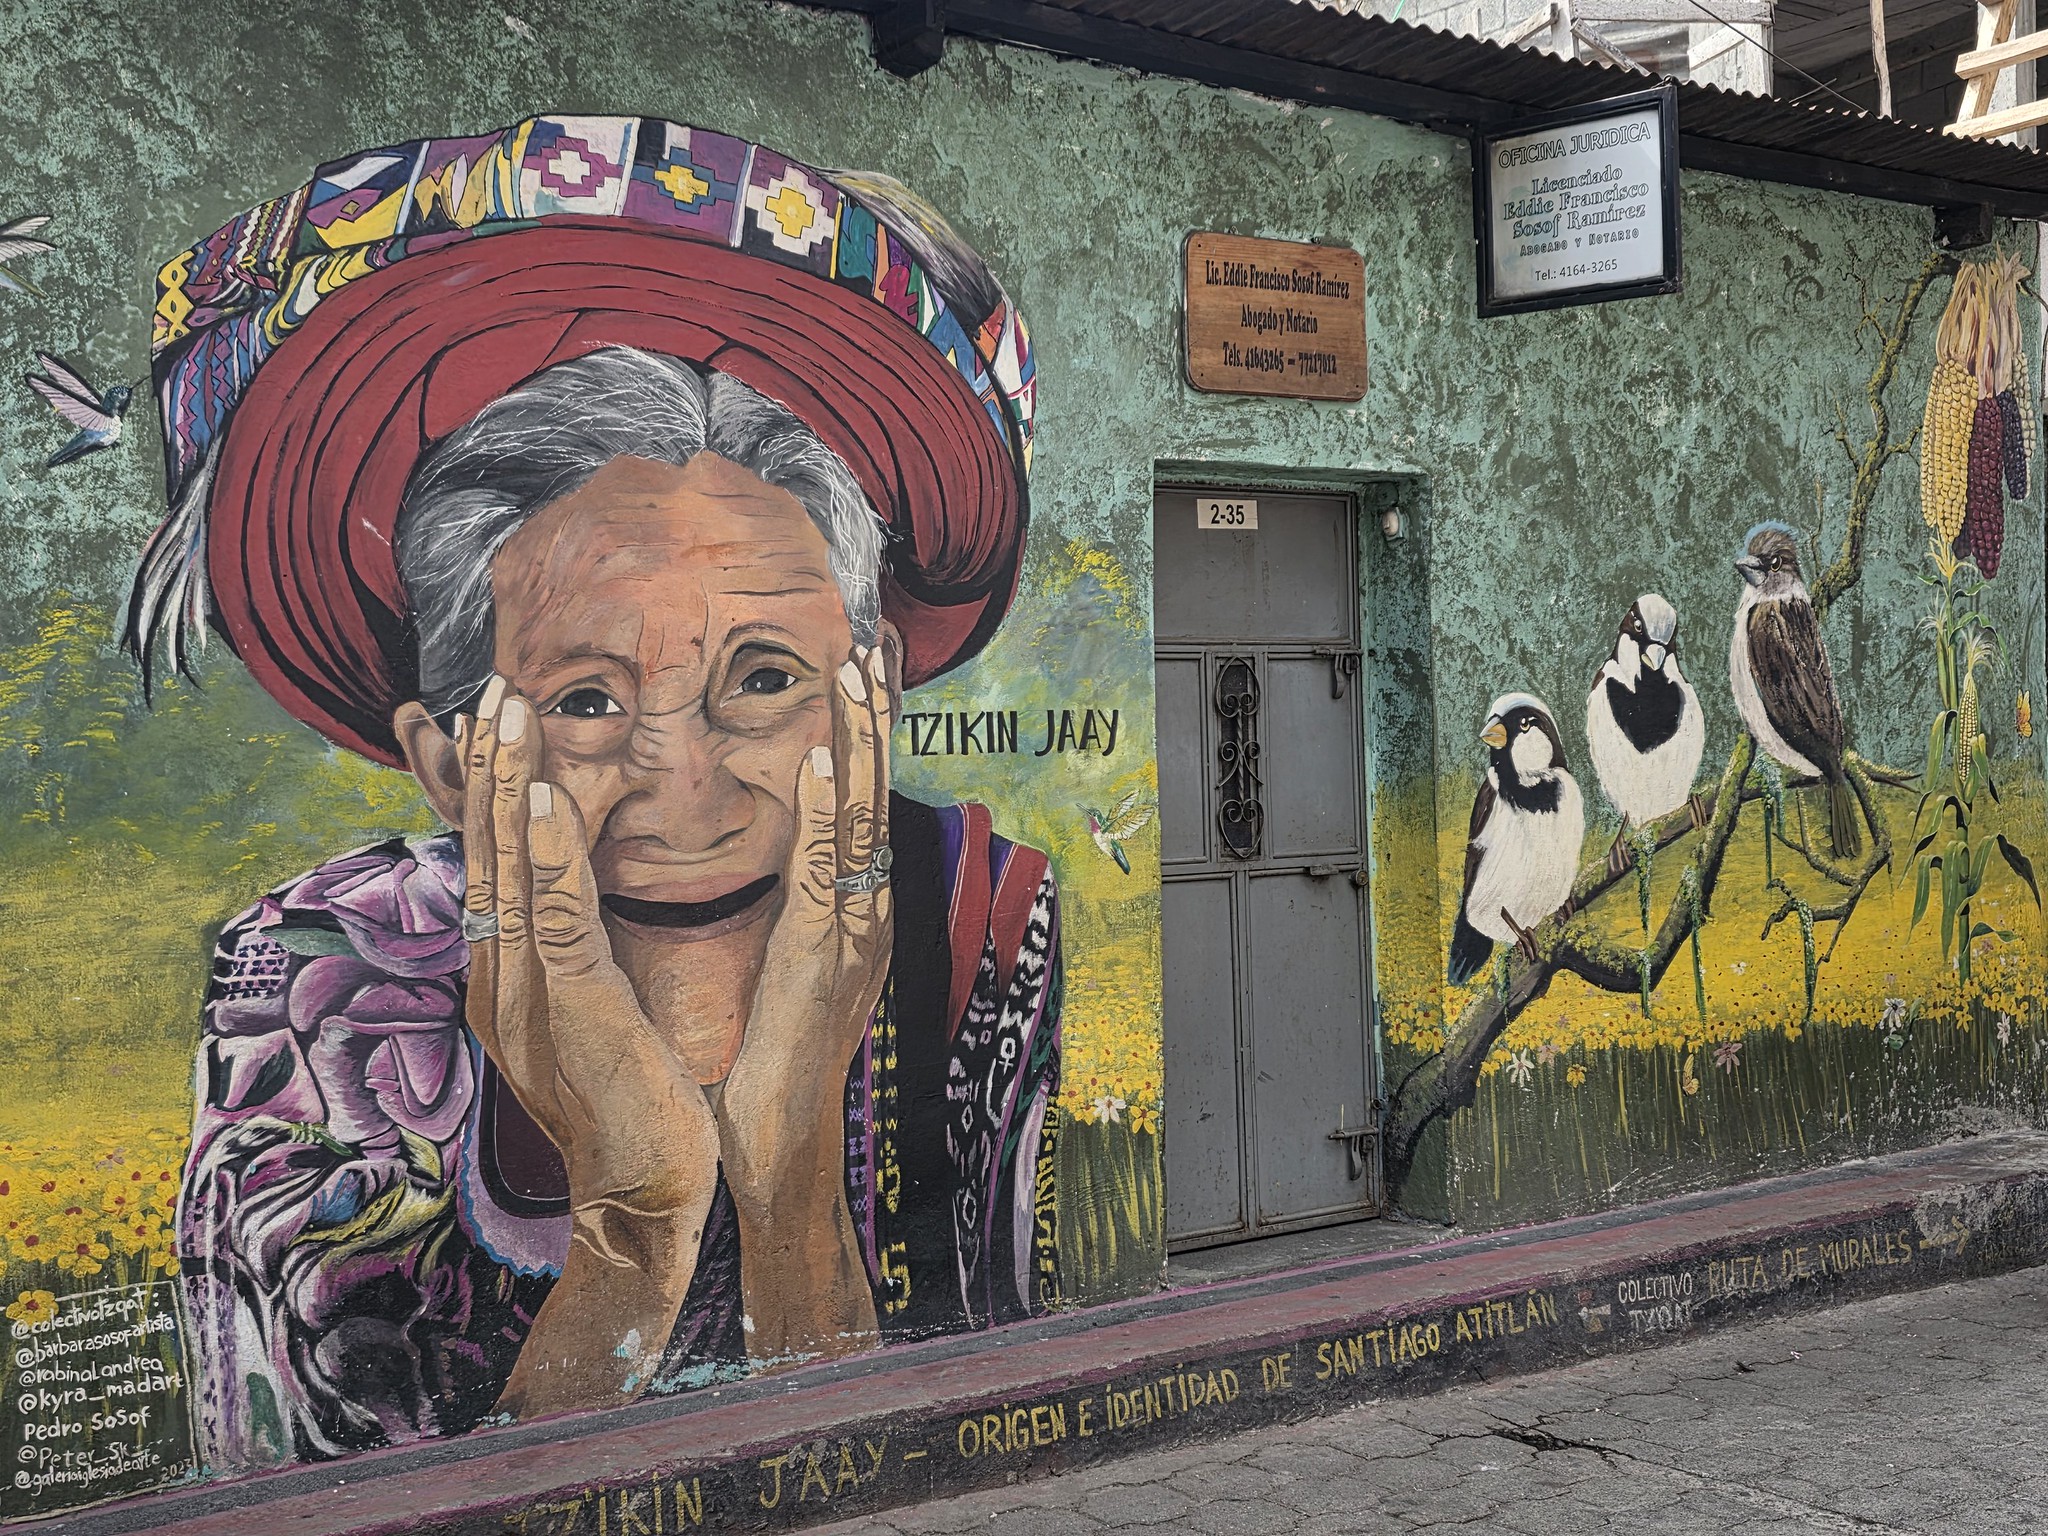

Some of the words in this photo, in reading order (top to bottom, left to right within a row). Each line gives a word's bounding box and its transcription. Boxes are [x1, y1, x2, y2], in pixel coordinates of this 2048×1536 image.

[1499, 139, 1566, 168] OFICINA
[1570, 122, 1651, 154] JURIDICA
[1532, 164, 1623, 196] Licenciado
[1503, 197, 1554, 221] Eddie
[1559, 183, 1649, 211] Francisco
[1512, 214, 1562, 239] Sosof
[1567, 204, 1646, 230] Ramírez
[1575, 237, 1582, 248] Y
[1205, 259, 1222, 286] Lic.
[1223, 261, 1248, 288] Eddie
[1249, 264, 1290, 292] Francisco
[1291, 268, 1315, 294] Sosof
[1315, 272, 1350, 300] Ramírez
[1535, 269, 1557, 281] Tel.:
[1559, 259, 1618, 277] 4164-3265
[1241, 303, 1277, 335] Abogado
[1278, 314, 1285, 336] y
[1286, 308, 1318, 334] Notario
[1223, 341, 1243, 367] Tels.
[1245, 346, 1284, 373] 41643265
[1298, 351, 1337, 377] 77217012
[1210, 503, 1245, 525] 2-35
[902, 710, 1018, 757] TZIKIN
[1034, 709, 1119, 757] JAAY
[1708, 1254, 1768, 1296] RUTA
[1781, 1247, 1810, 1280] DE
[1819, 1228, 1913, 1275] MURALES
[1618, 1272, 1693, 1304] COLECTIVO
[958, 1403, 1067, 1458] ORIGEN
[1078, 1398, 1094, 1437] E
[1105, 1362, 1240, 1430] IDENTIDAD
[1262, 1352, 1293, 1392] DE
[1315, 1318, 1440, 1381] SANTIAGO
